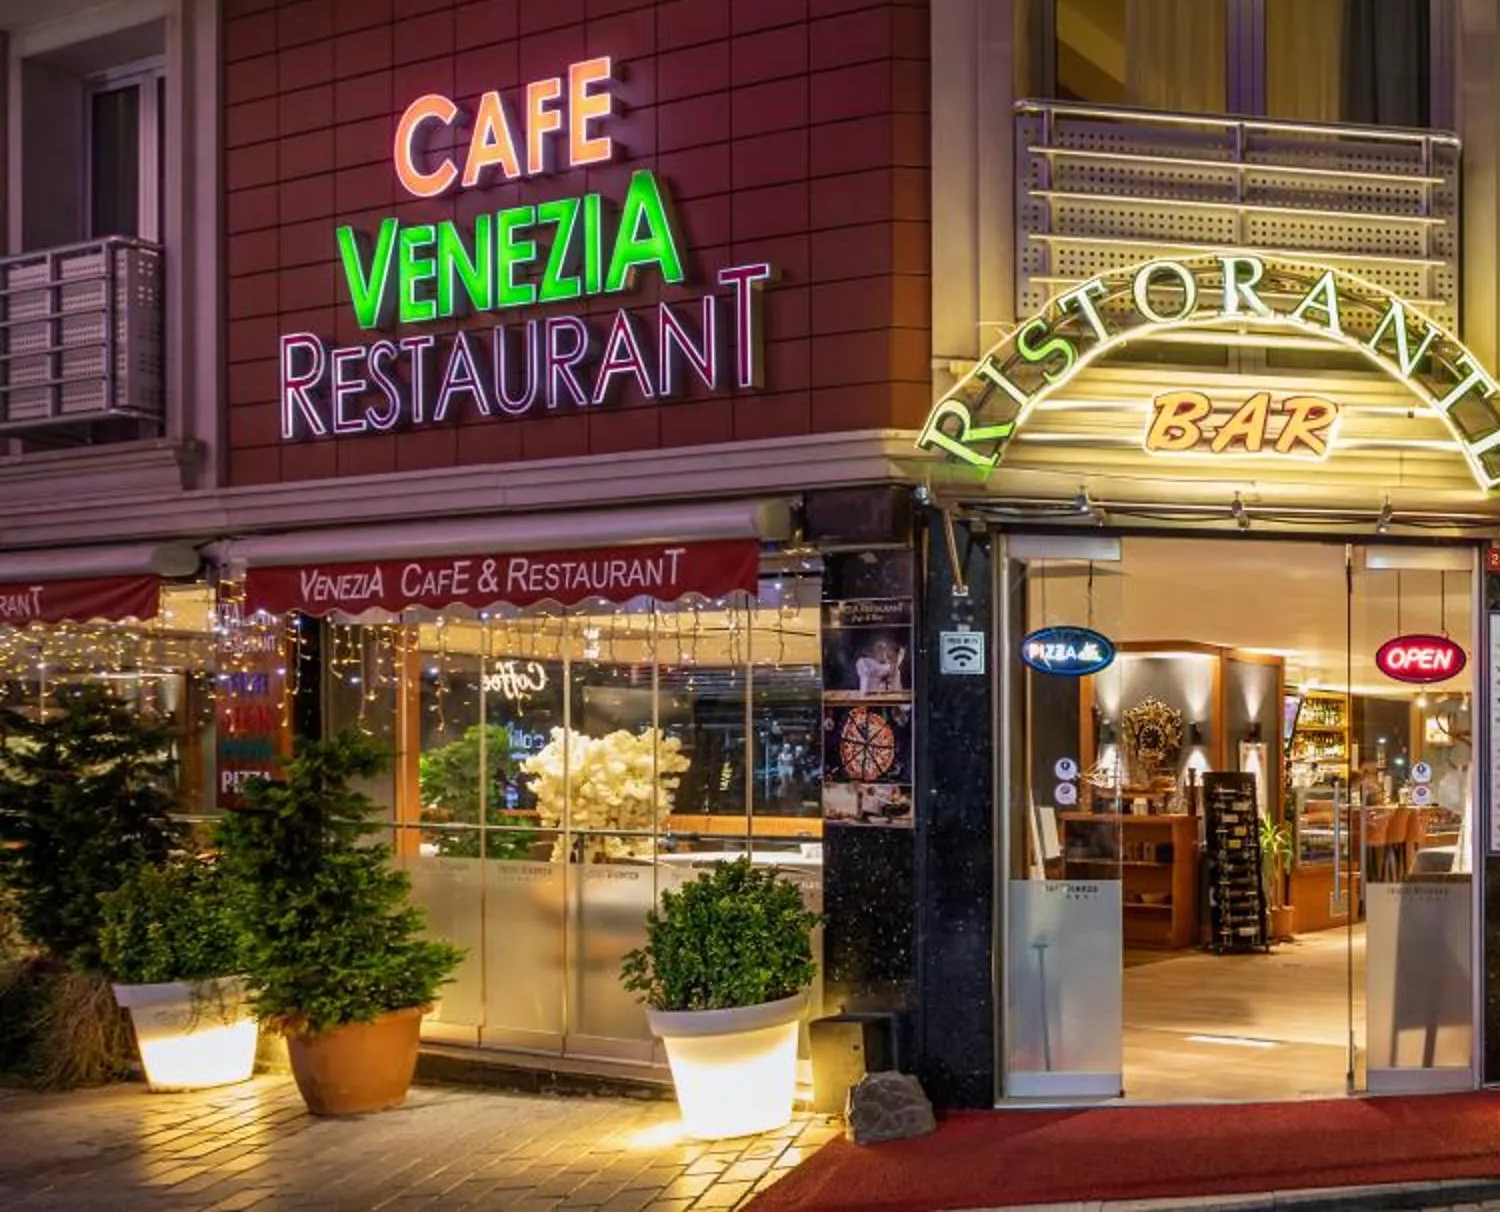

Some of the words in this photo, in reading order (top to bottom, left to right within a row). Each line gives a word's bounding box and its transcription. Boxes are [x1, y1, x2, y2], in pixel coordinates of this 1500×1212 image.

[394, 55, 612, 198] CAFE
[336, 169, 684, 330] VENEZIA
[280, 263, 770, 440] RESTAURANT
[1149, 390, 1341, 455] BAR
[300, 566, 385, 603] VENEZIA
[401, 560, 472, 598] CAFE
[477, 559, 499, 593] &
[507, 548, 687, 594] RESTAURANT
[1028, 642, 1077, 661] PIZZA
[1385, 647, 1454, 670] OPEN
